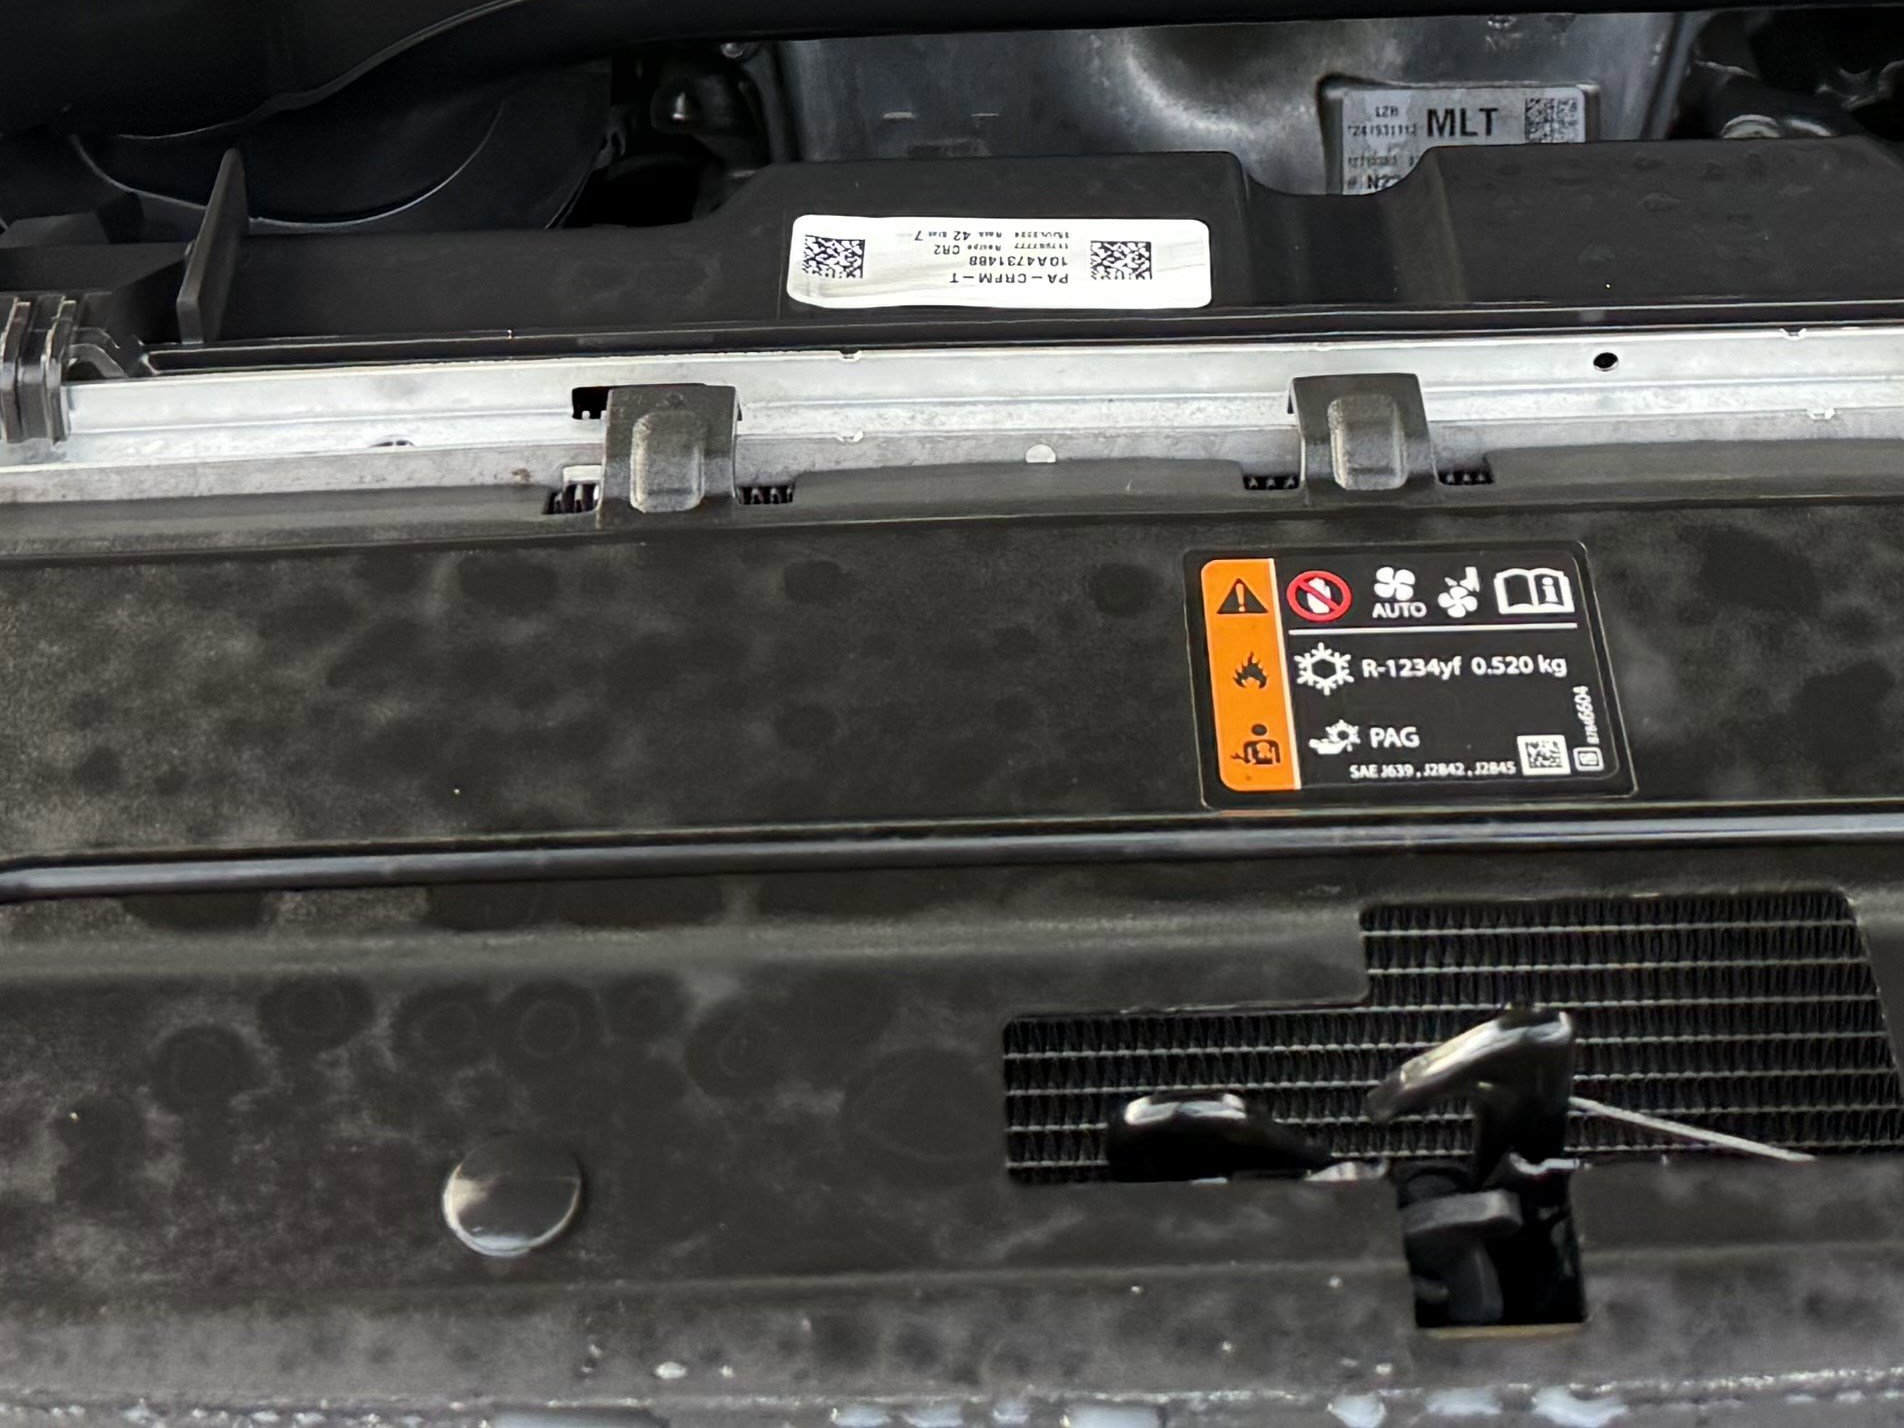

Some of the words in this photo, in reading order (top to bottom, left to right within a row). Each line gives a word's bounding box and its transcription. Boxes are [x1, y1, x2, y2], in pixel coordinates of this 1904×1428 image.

[1427, 107, 1499, 137] MLT
[914, 230, 924, 241] 7
[953, 230, 971, 241] 42
[934, 244, 960, 255] CR2
[1371, 602, 1427, 619] AUTO
[1361, 655, 1462, 680] R-1234yf
[1470, 655, 1534, 676] 0.520
[1537, 654, 1568, 678] kg
[1369, 726, 1421, 748] PAG
[1349, 764, 1378, 779] SAE
[1475, 761, 1517, 775] J2845
